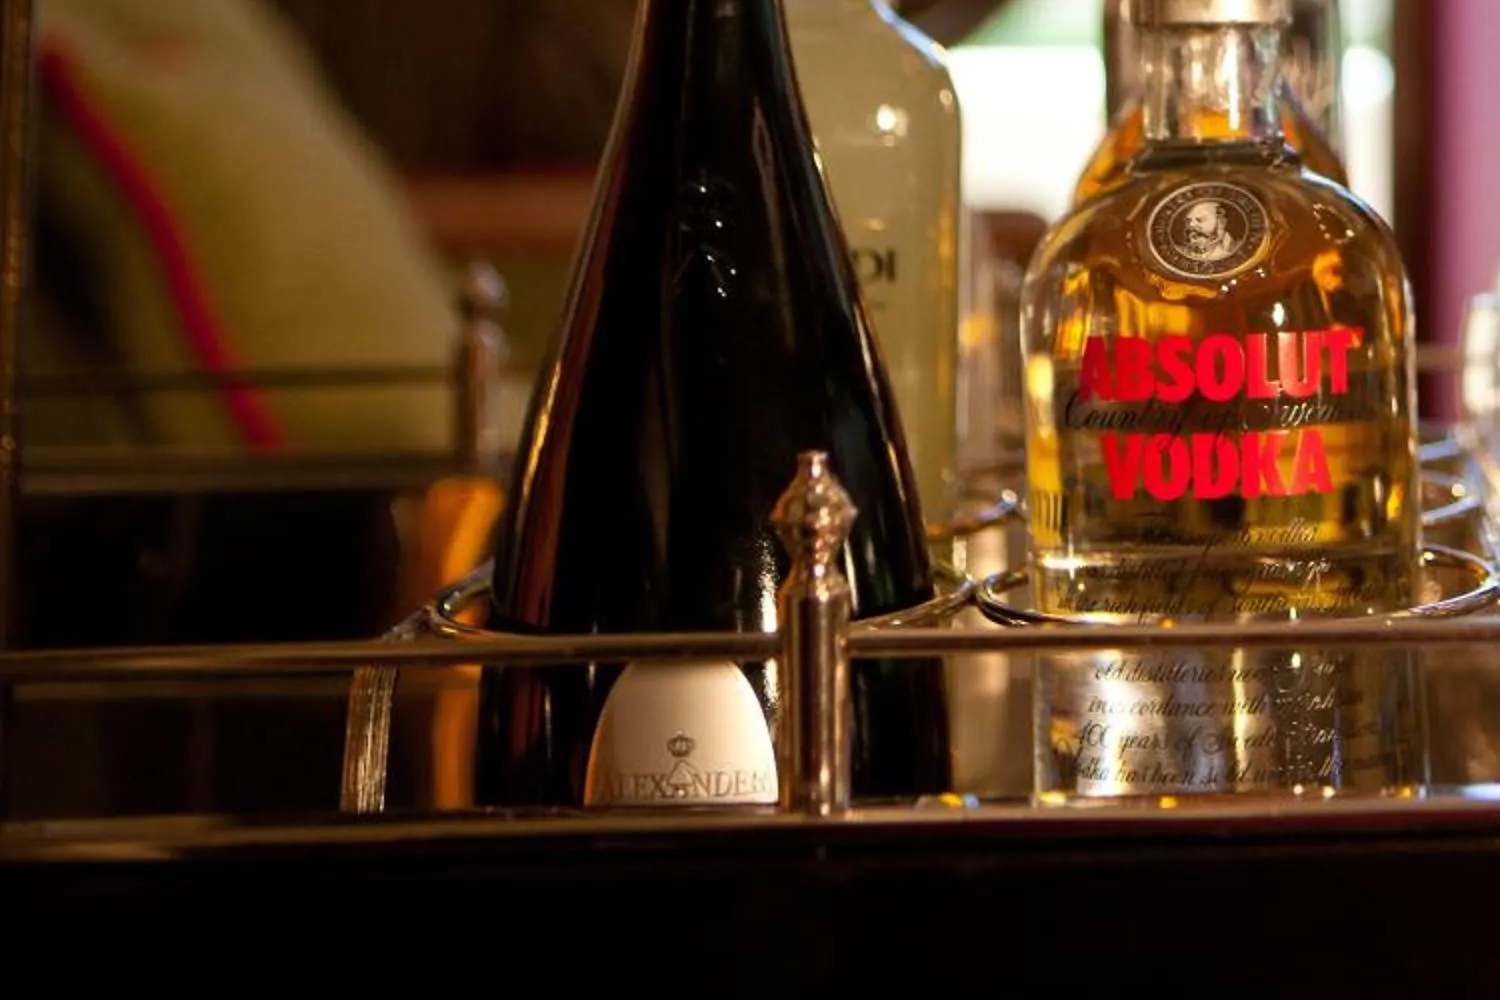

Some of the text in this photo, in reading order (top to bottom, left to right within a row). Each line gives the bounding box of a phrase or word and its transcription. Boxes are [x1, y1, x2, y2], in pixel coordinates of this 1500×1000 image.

[1077, 327, 1364, 404] ABSOLUT
[1102, 430, 1334, 501] VODKA
[599, 759, 770, 799] ALEXANDER
